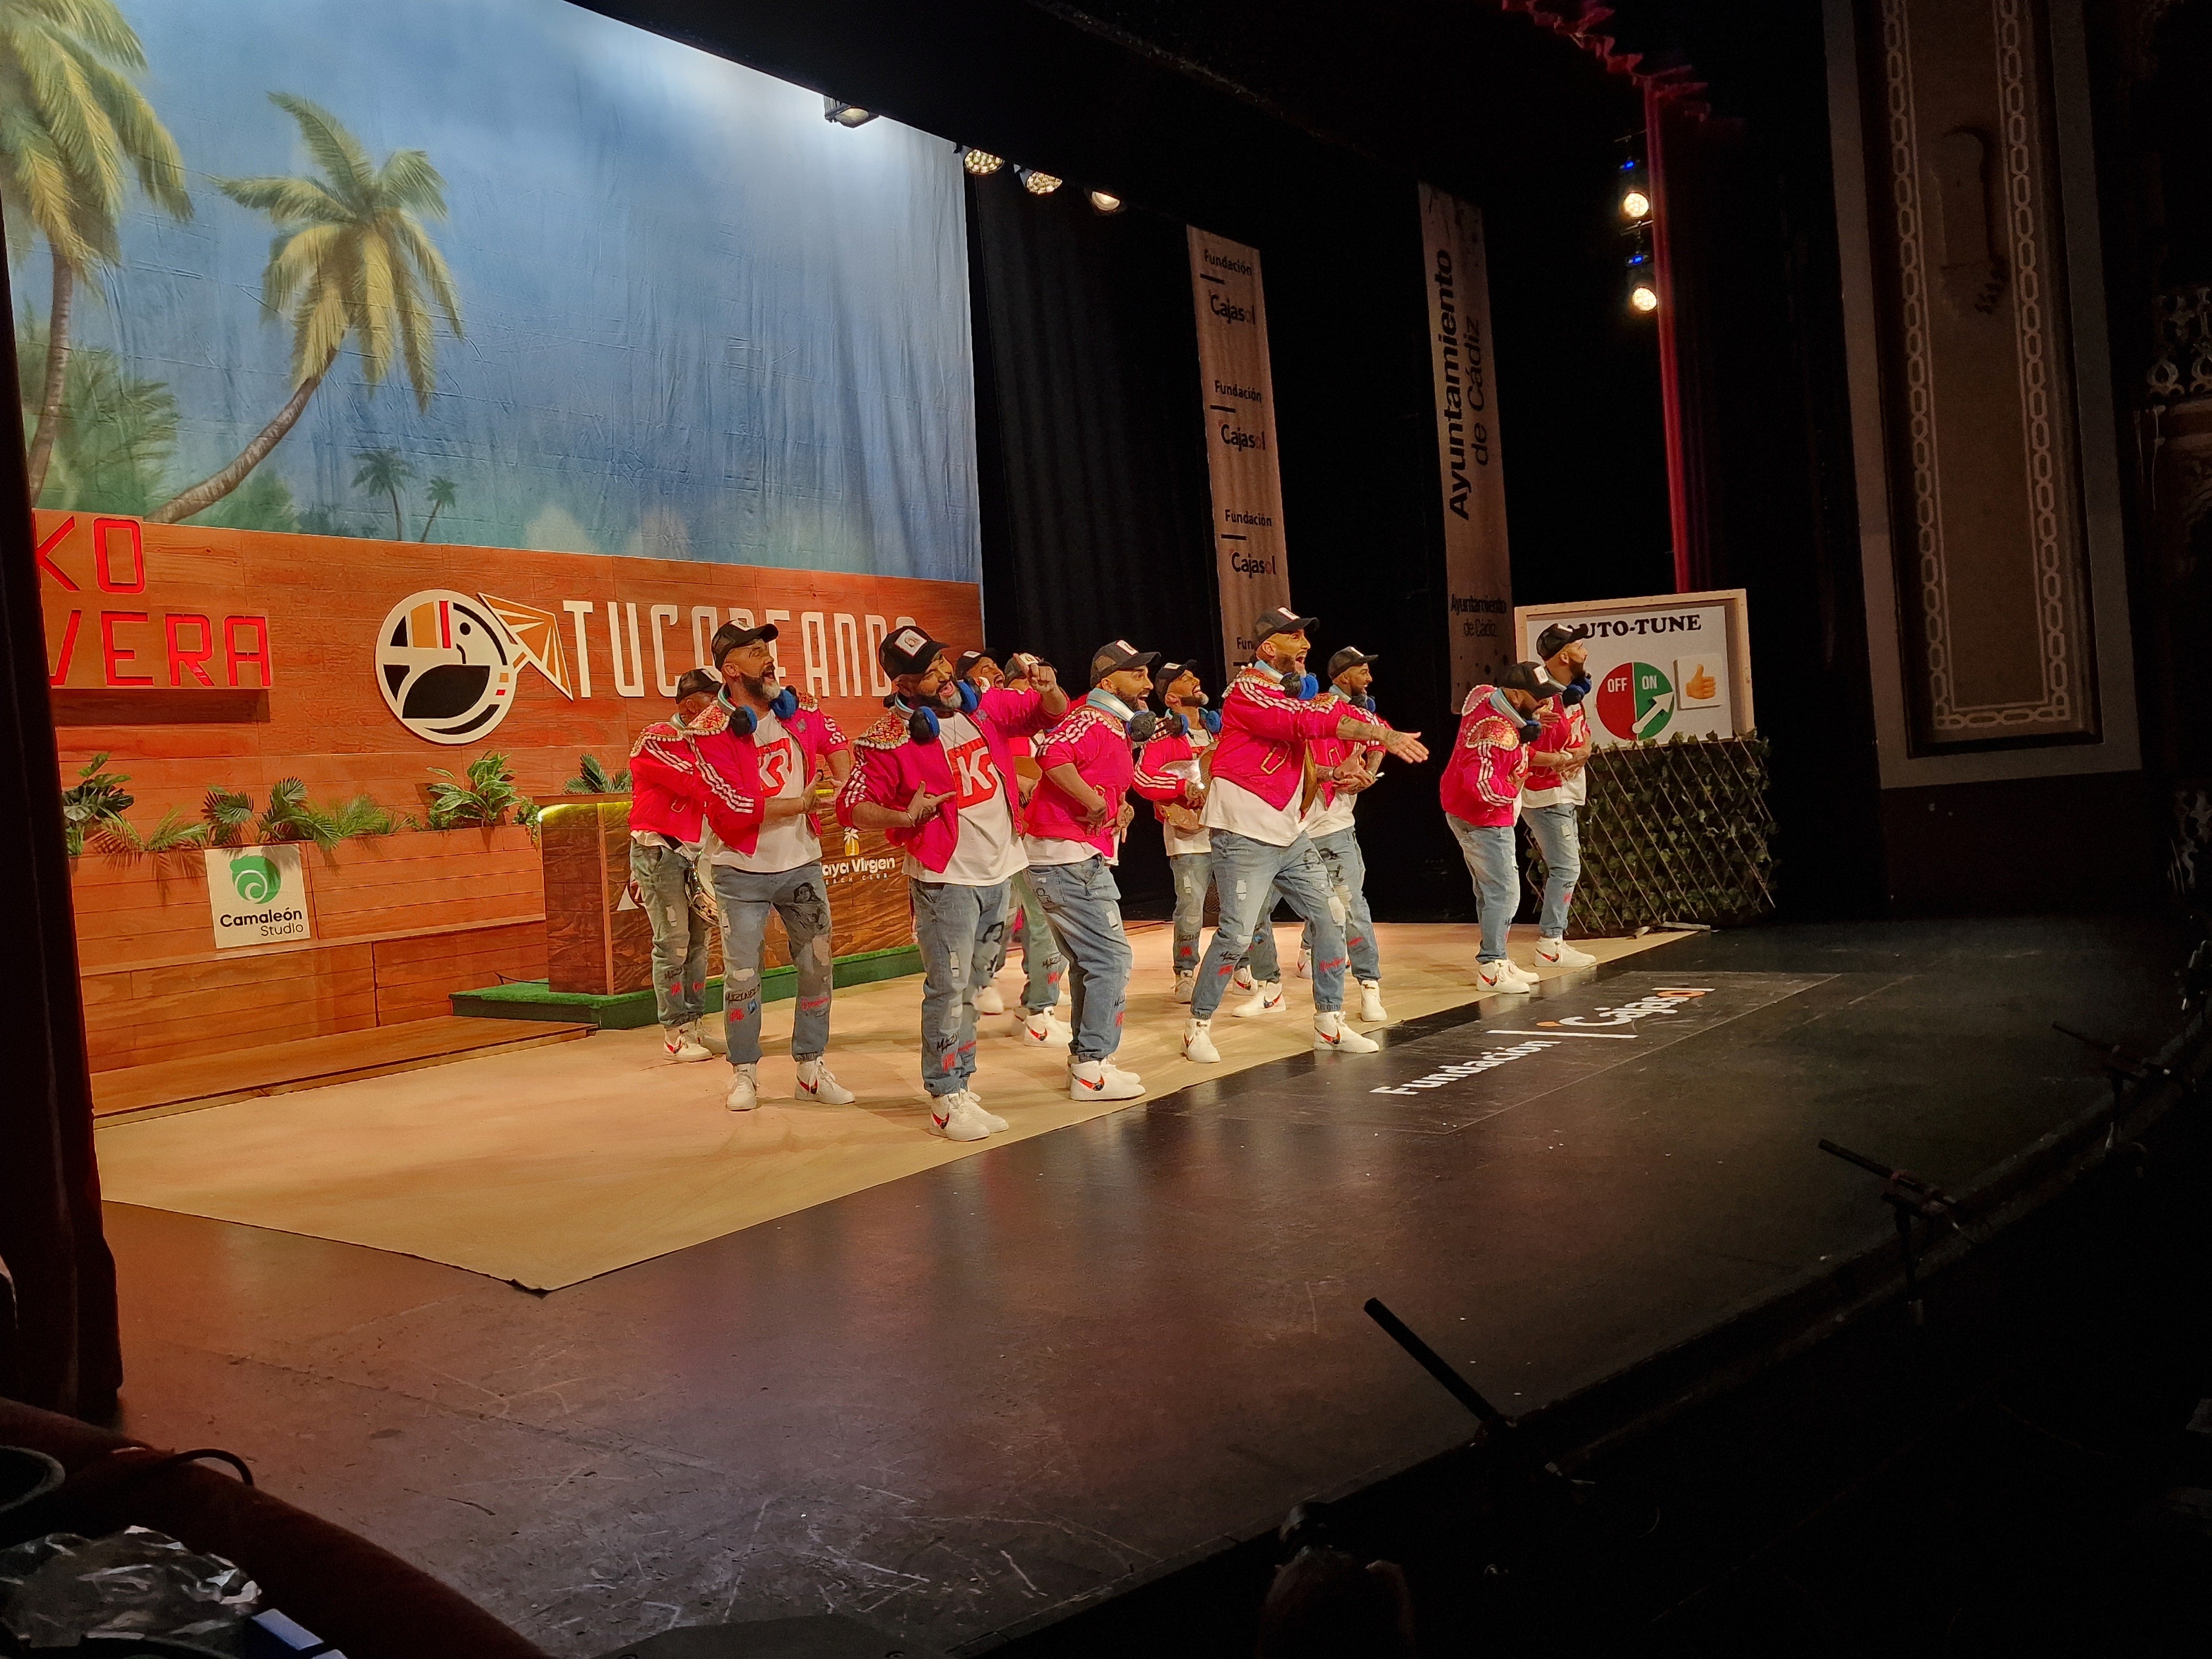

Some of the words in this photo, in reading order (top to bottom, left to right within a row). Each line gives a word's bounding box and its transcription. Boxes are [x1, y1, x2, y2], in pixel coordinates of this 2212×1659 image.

[1204, 248, 1253, 276] Fundación
[1210, 293, 1256, 325] Cajasol
[1463, 315, 1485, 412] Cádiz
[1214, 379, 1262, 403] Fundación
[1434, 249, 1472, 520] Ayuntamiento
[1220, 423, 1266, 452] Cajasol
[1472, 422, 1488, 466] de
[1225, 509, 1272, 527] Fundación
[1231, 552, 1277, 579] Cajasol
[1567, 614, 1702, 639] UTO-TUNE
[1607, 677, 1627, 693] OFF
[1641, 675, 1658, 690] ON
[820, 862, 850, 878] aya
[851, 857, 895, 874] Virgen
[862, 873, 888, 881] CLUB
[220, 907, 302, 928] Camaleón
[260, 922, 304, 937] Studio
[1369, 1040, 1562, 1095] Fundación
[1558, 987, 1716, 1026] Cajasol
